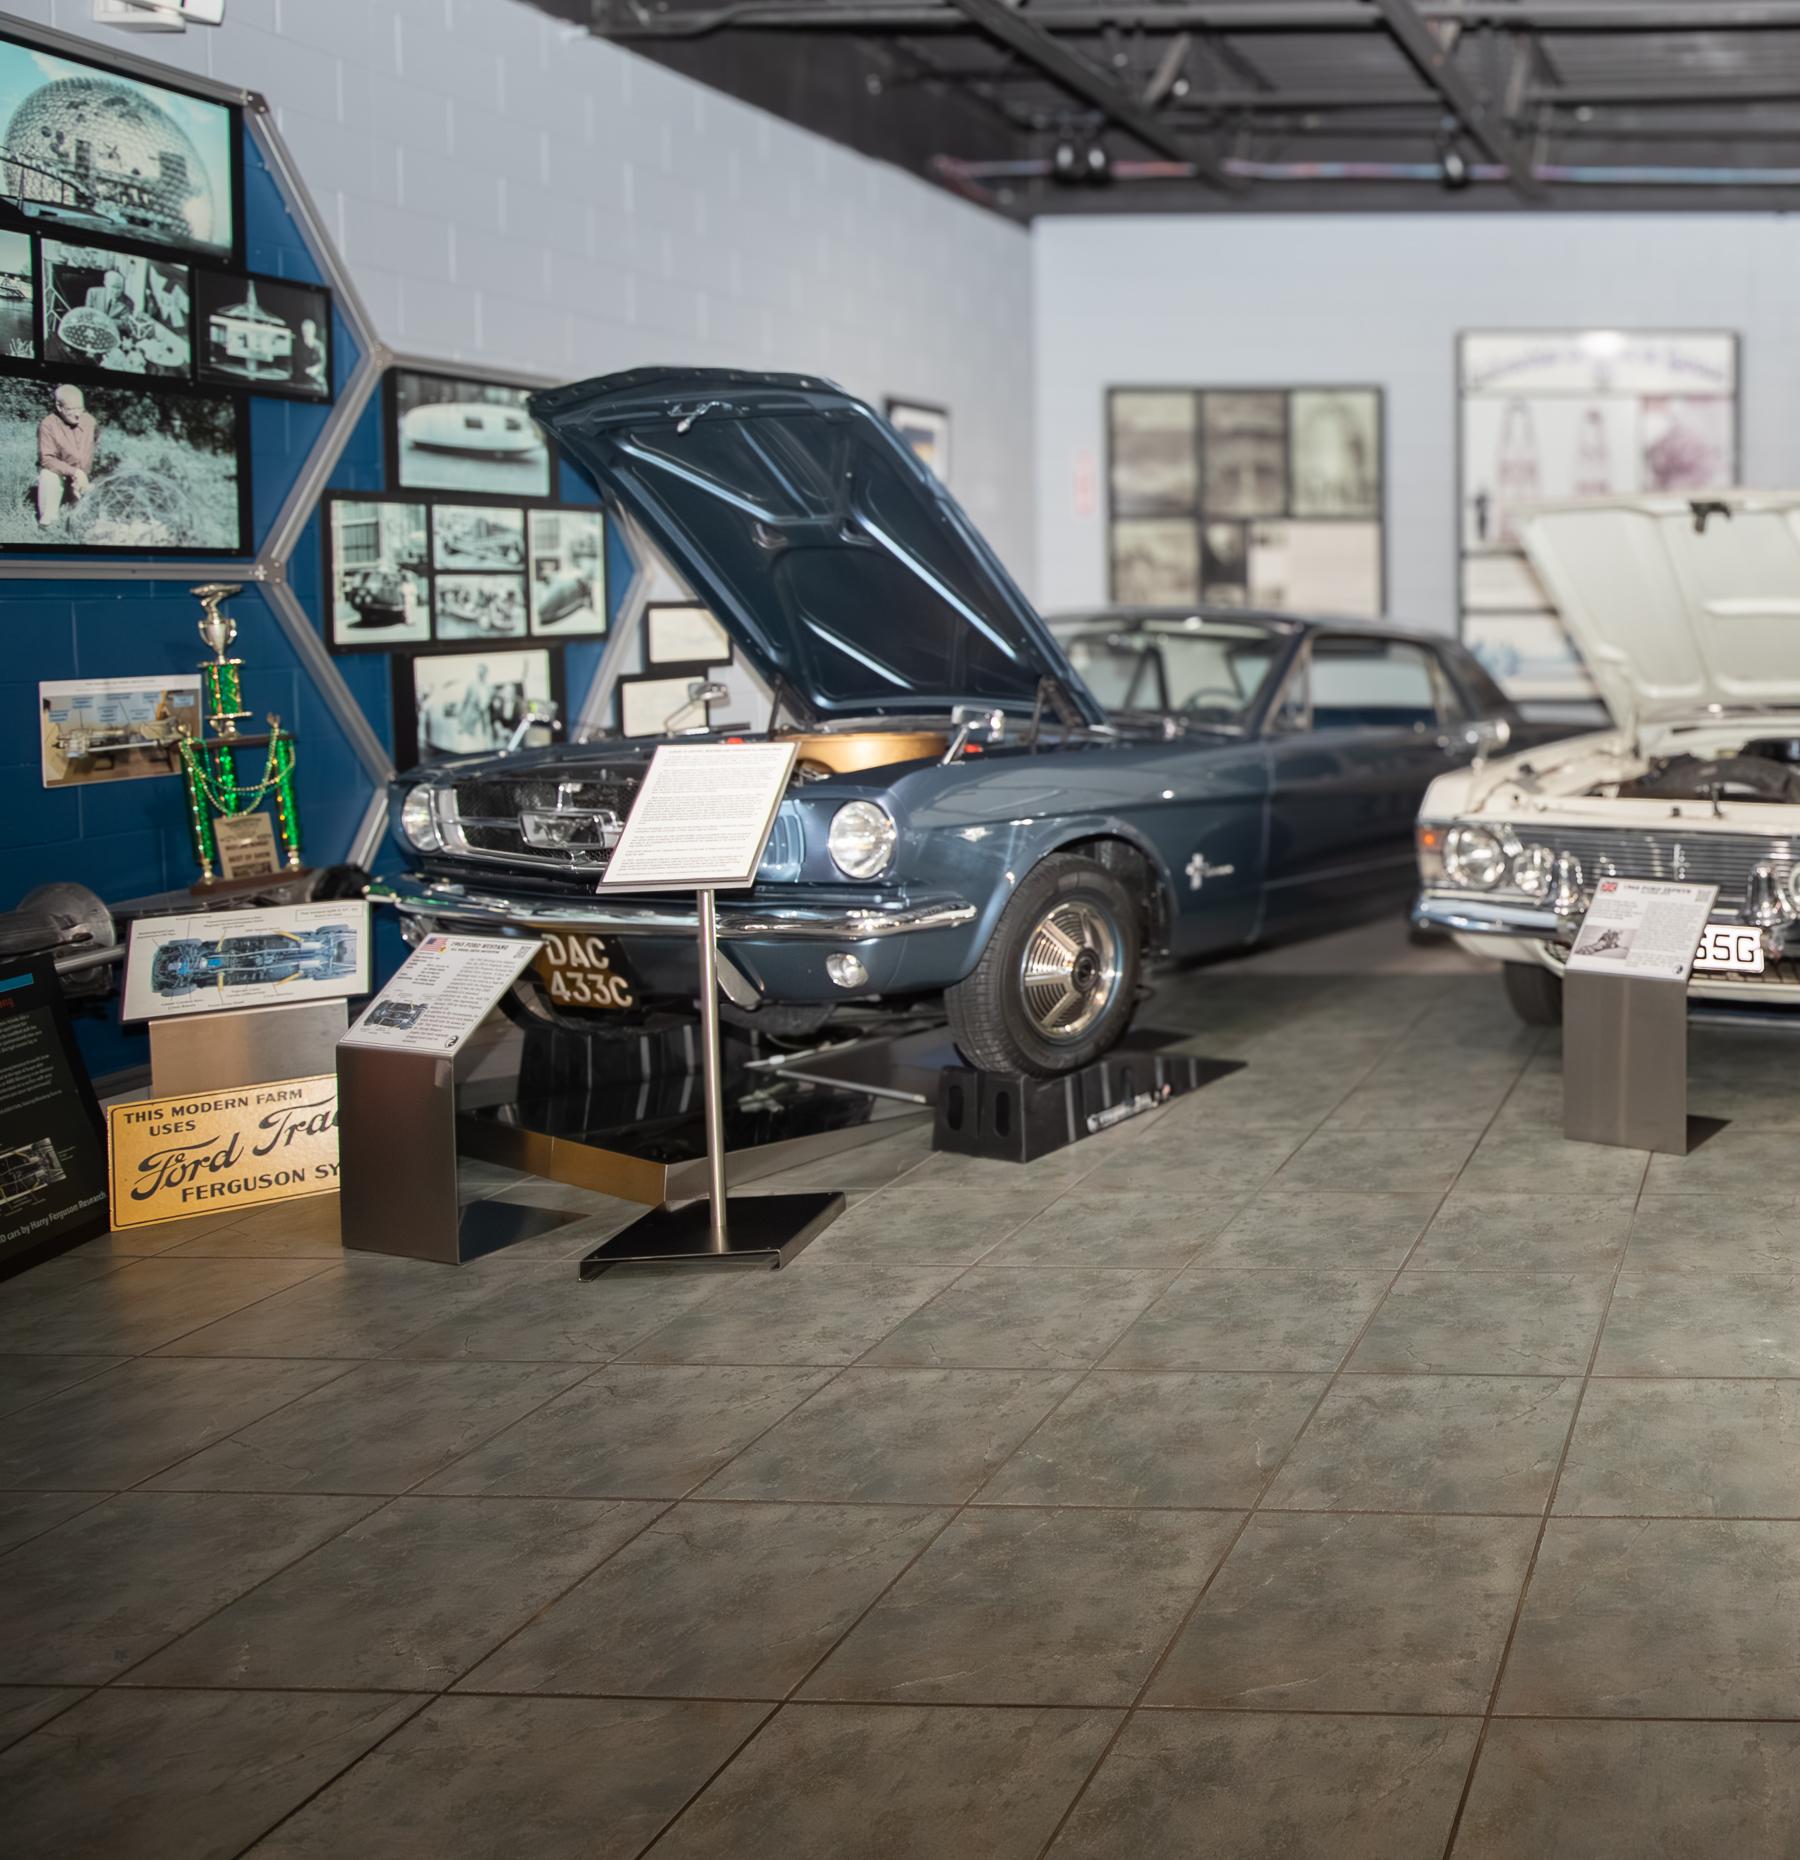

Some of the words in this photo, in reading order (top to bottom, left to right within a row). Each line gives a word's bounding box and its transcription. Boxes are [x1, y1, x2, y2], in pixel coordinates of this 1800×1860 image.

[541, 933, 609, 969] DAC
[551, 970, 633, 1008] 433C
[124, 1108, 164, 1124] THIS
[171, 1096, 249, 1118] MODERN
[256, 1088, 303, 1105] FARM
[149, 1120, 196, 1137] USES
[130, 1131, 245, 1201] Ford
[182, 1167, 305, 1203] FERGUSON
[20, 1224, 30, 1234] by
[30, 1216, 49, 1230] Harry
[48, 1204, 79, 1222] Ferguson
[78, 1191, 106, 1209] Research
